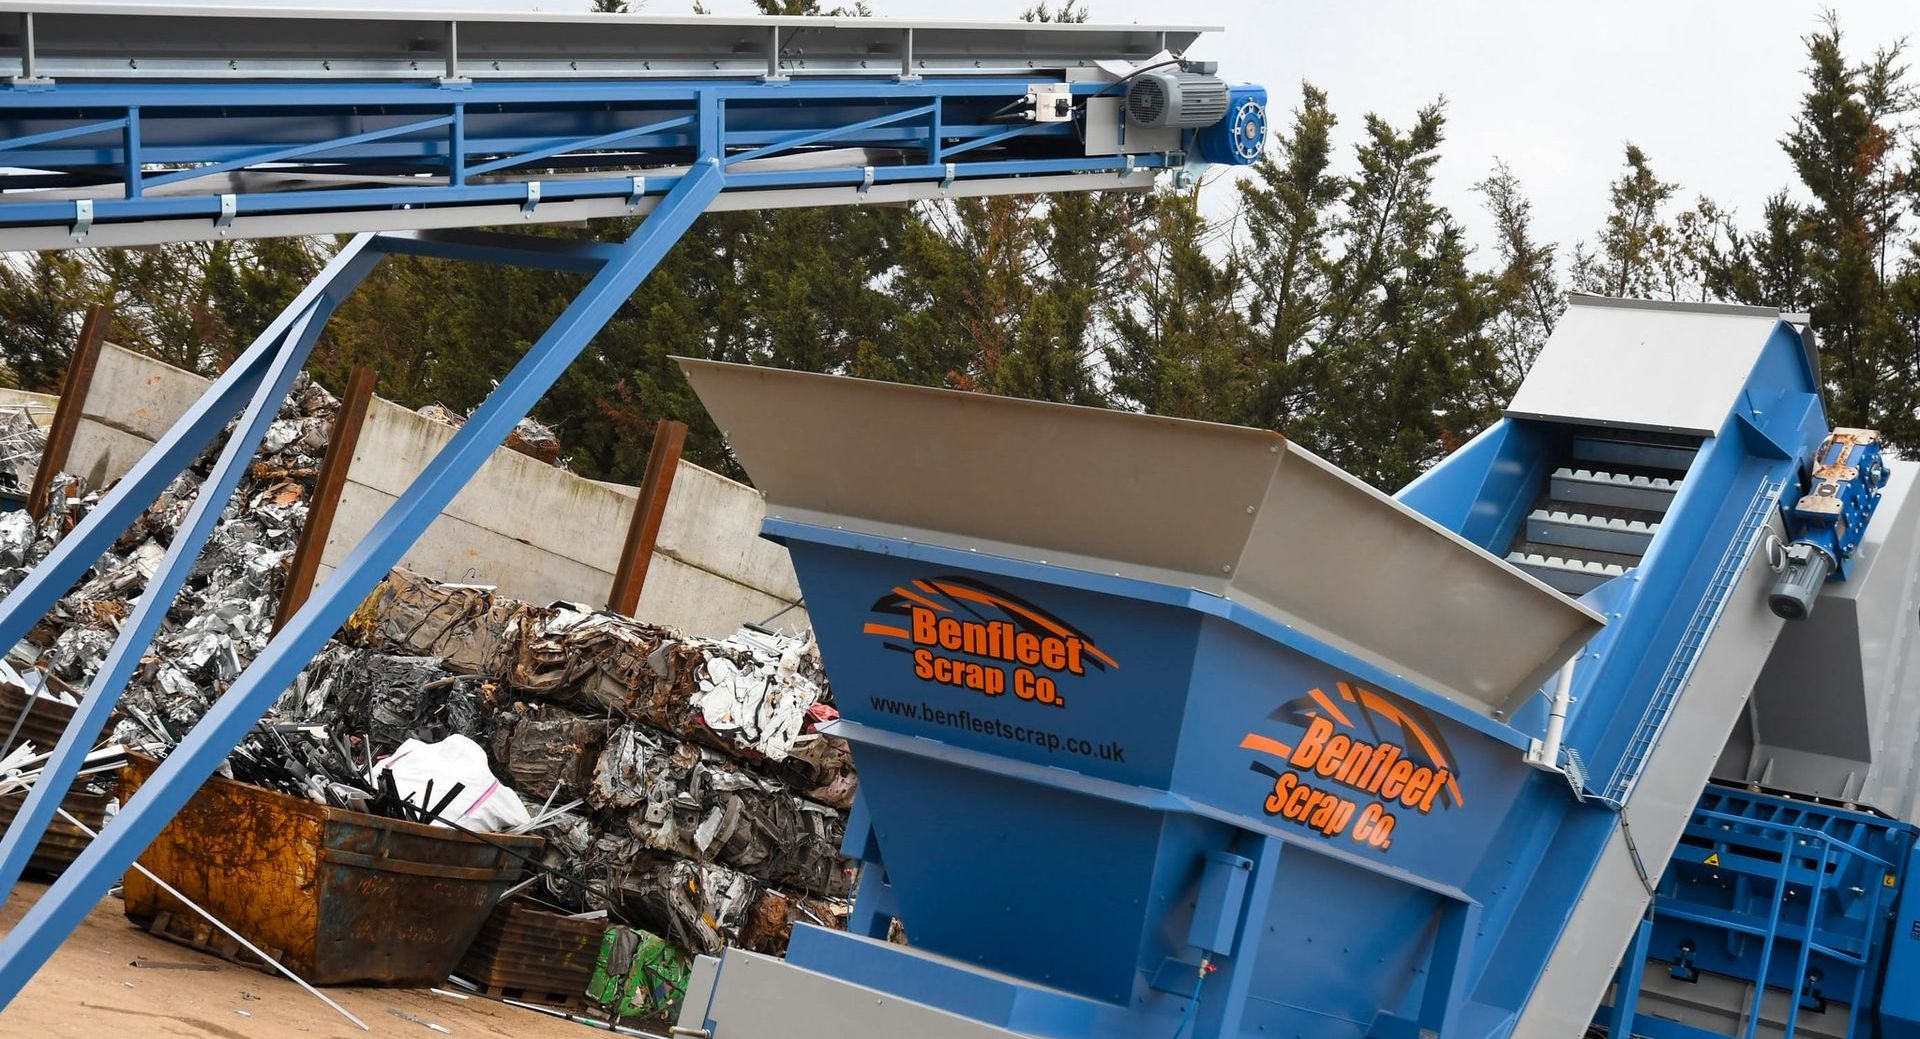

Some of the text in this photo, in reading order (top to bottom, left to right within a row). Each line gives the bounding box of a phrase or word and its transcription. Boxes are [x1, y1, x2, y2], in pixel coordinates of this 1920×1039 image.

[911, 605, 1084, 676] Benfleet
[914, 648, 1064, 707] Scrap Co.
[870, 696, 1125, 762] www.benfleetscrap.co.uk
[1288, 715, 1450, 815] Benfleet
[1264, 771, 1396, 851] Scrap Co.
